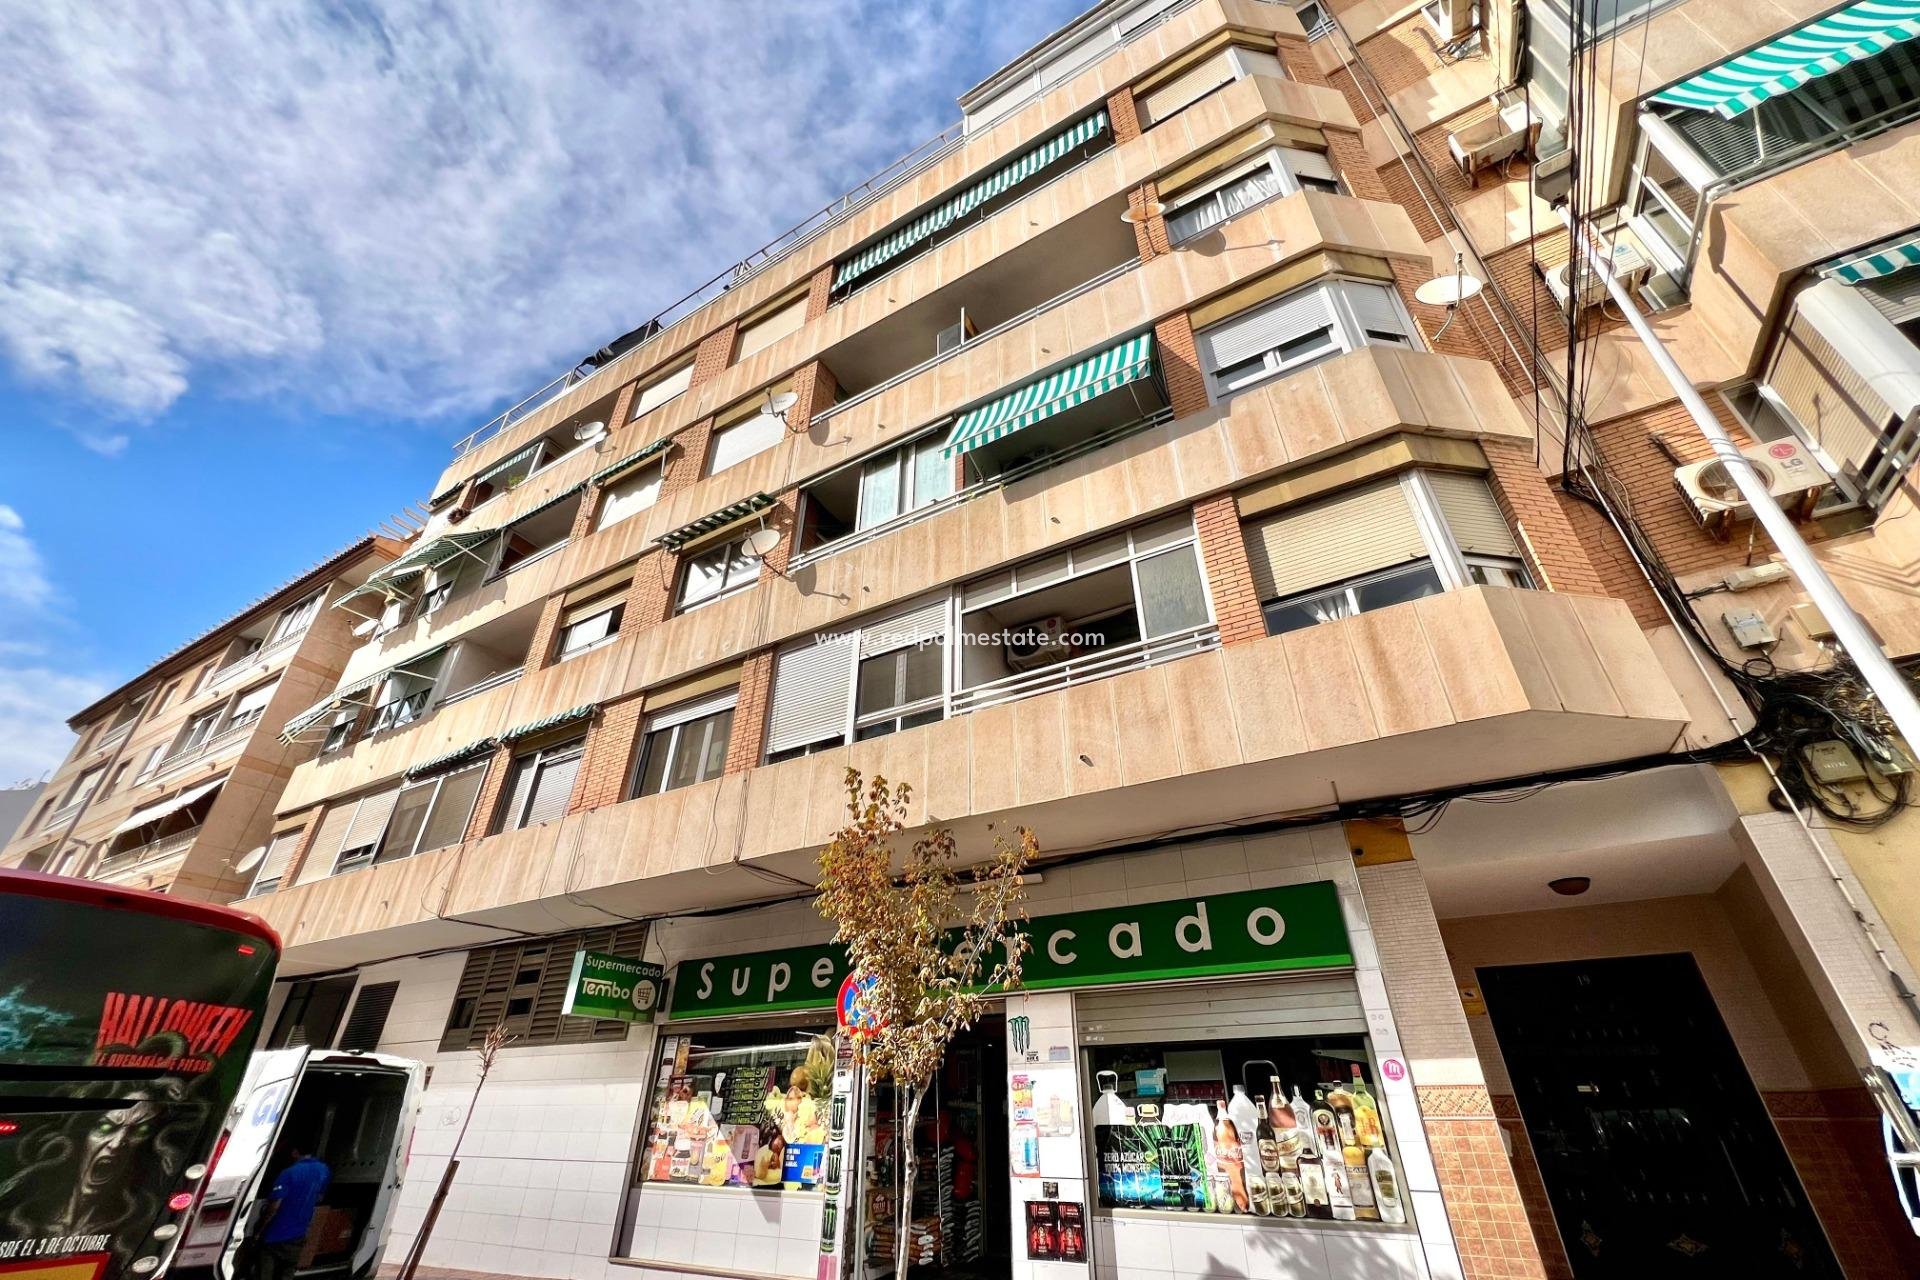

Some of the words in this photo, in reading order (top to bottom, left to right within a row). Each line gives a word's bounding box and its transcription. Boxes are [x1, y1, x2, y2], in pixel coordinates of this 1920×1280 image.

[586, 955, 661, 978] Supermercado
[582, 977, 630, 999] Tembo
[20, 1239, 36, 1256] EL
[62, 1234, 111, 1253] OCTUBRE
